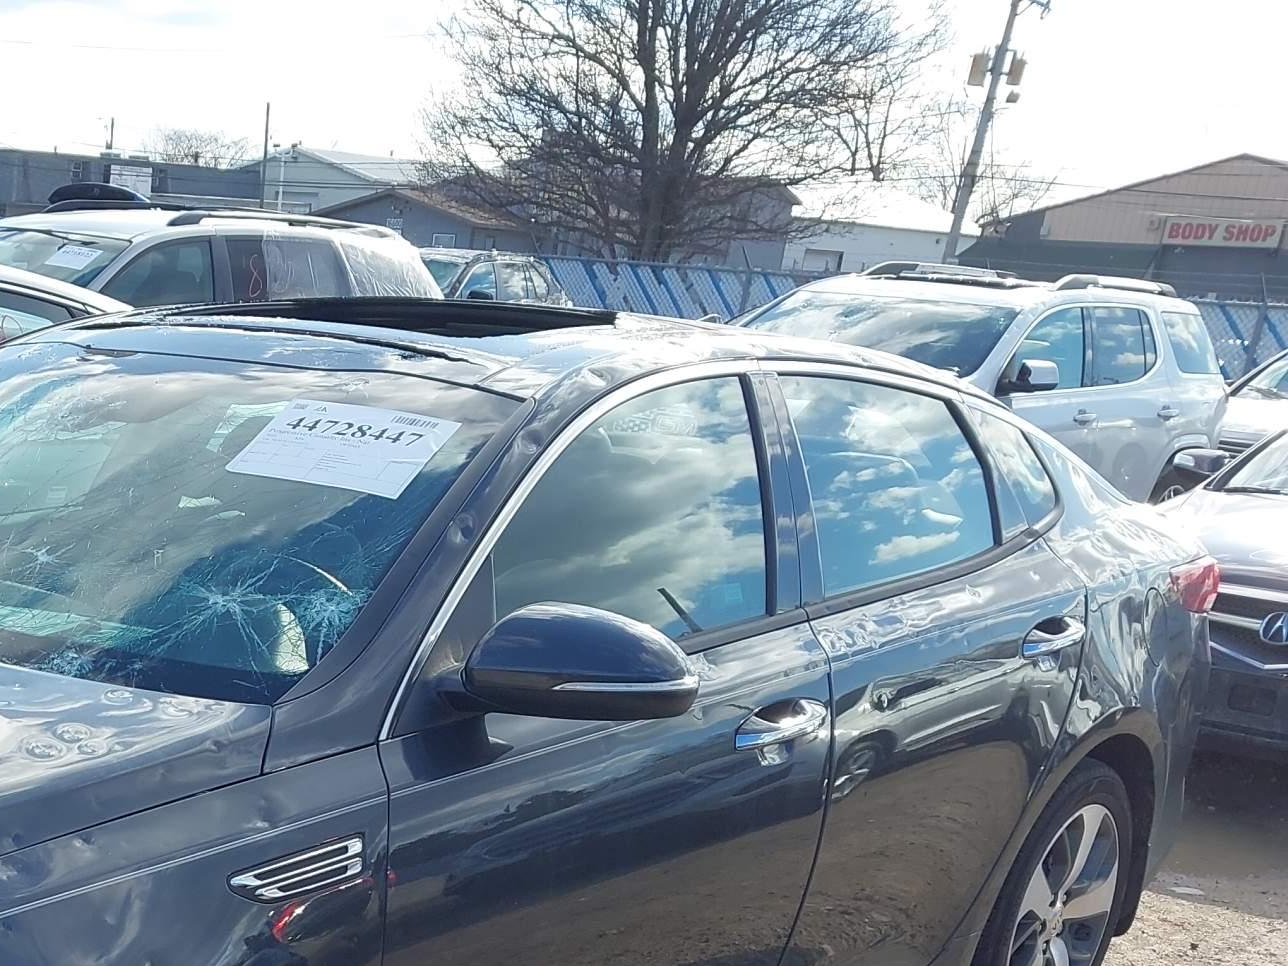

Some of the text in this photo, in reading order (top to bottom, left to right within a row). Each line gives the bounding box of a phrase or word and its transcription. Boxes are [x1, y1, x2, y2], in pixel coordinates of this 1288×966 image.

[1168, 222, 1277, 242] BODY SHOP
[286, 416, 427, 447] 44728447
